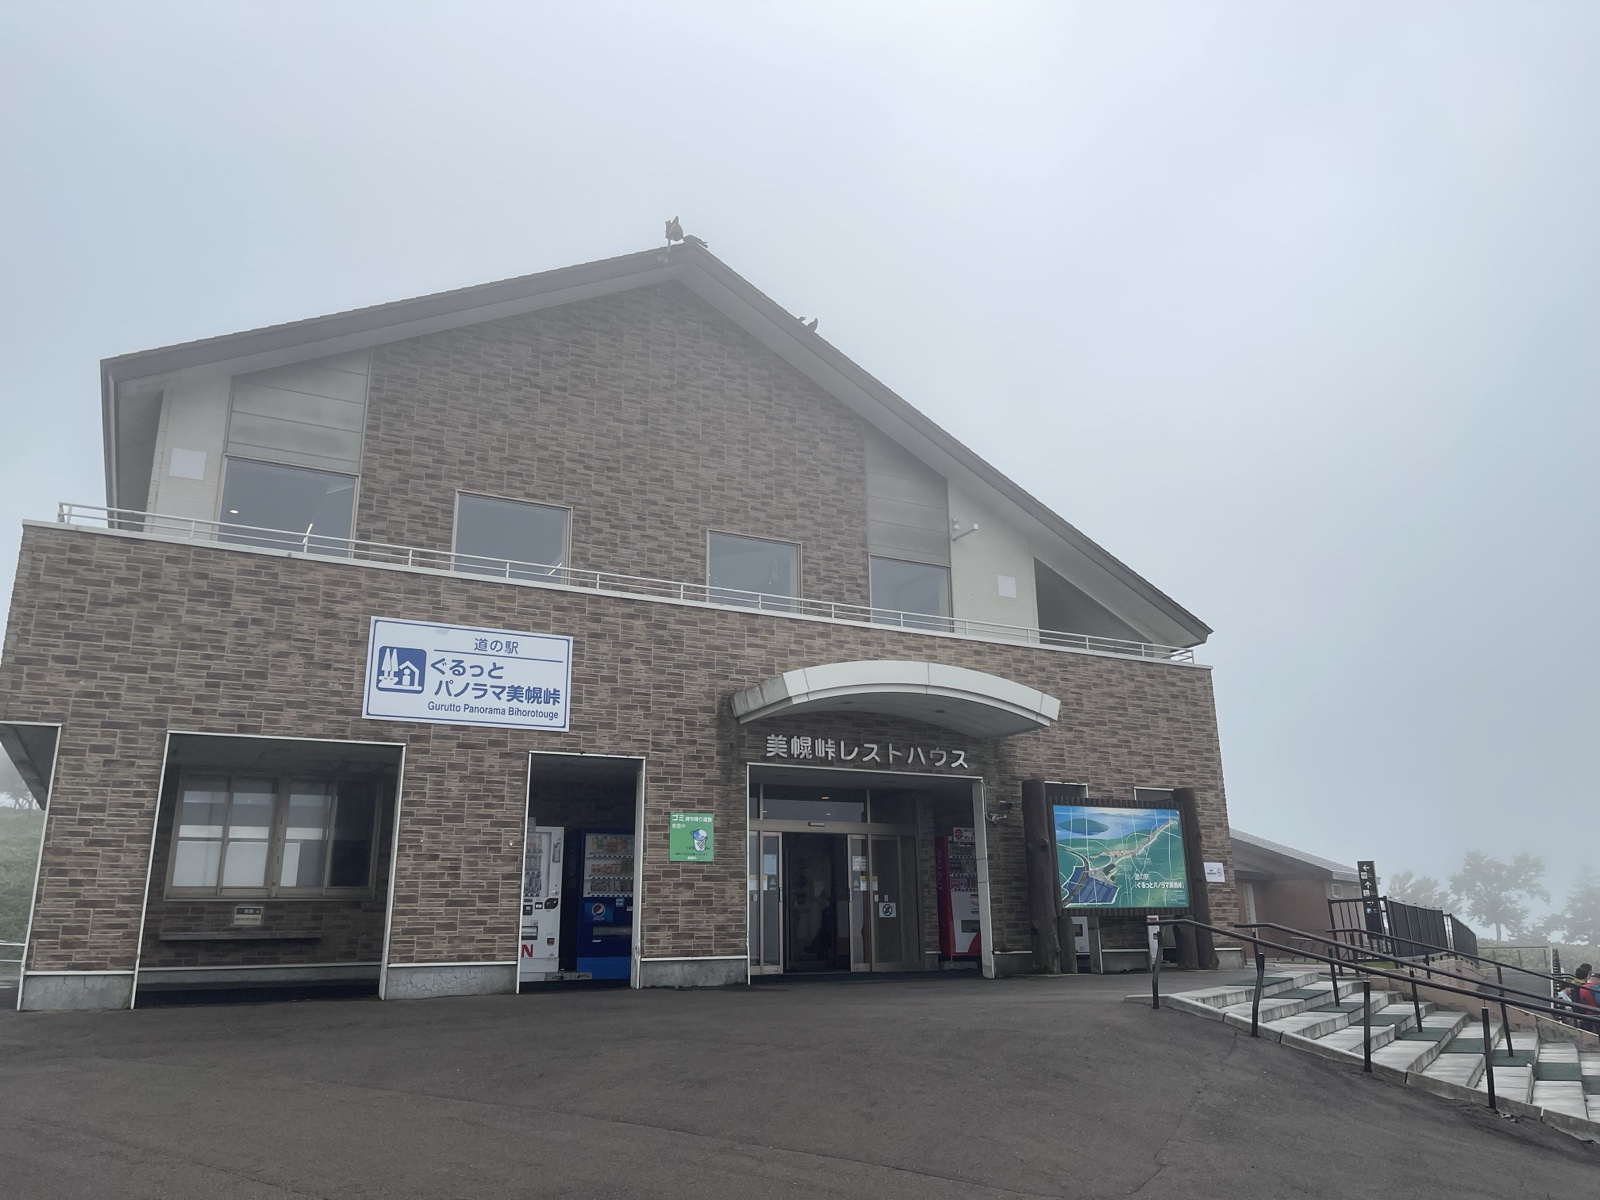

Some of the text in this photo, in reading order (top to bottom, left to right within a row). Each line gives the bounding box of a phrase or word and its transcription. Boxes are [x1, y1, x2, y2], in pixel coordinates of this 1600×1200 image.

[474, 638, 518, 654] 道の駅
[430, 658, 504, 679] ぐるっと
[434, 680, 560, 706] パノラマ美幌峠
[428, 701, 559, 721] Gurutto Panorama Bihorotouge
[766, 734, 968, 768] 美幌峠レストハウス
